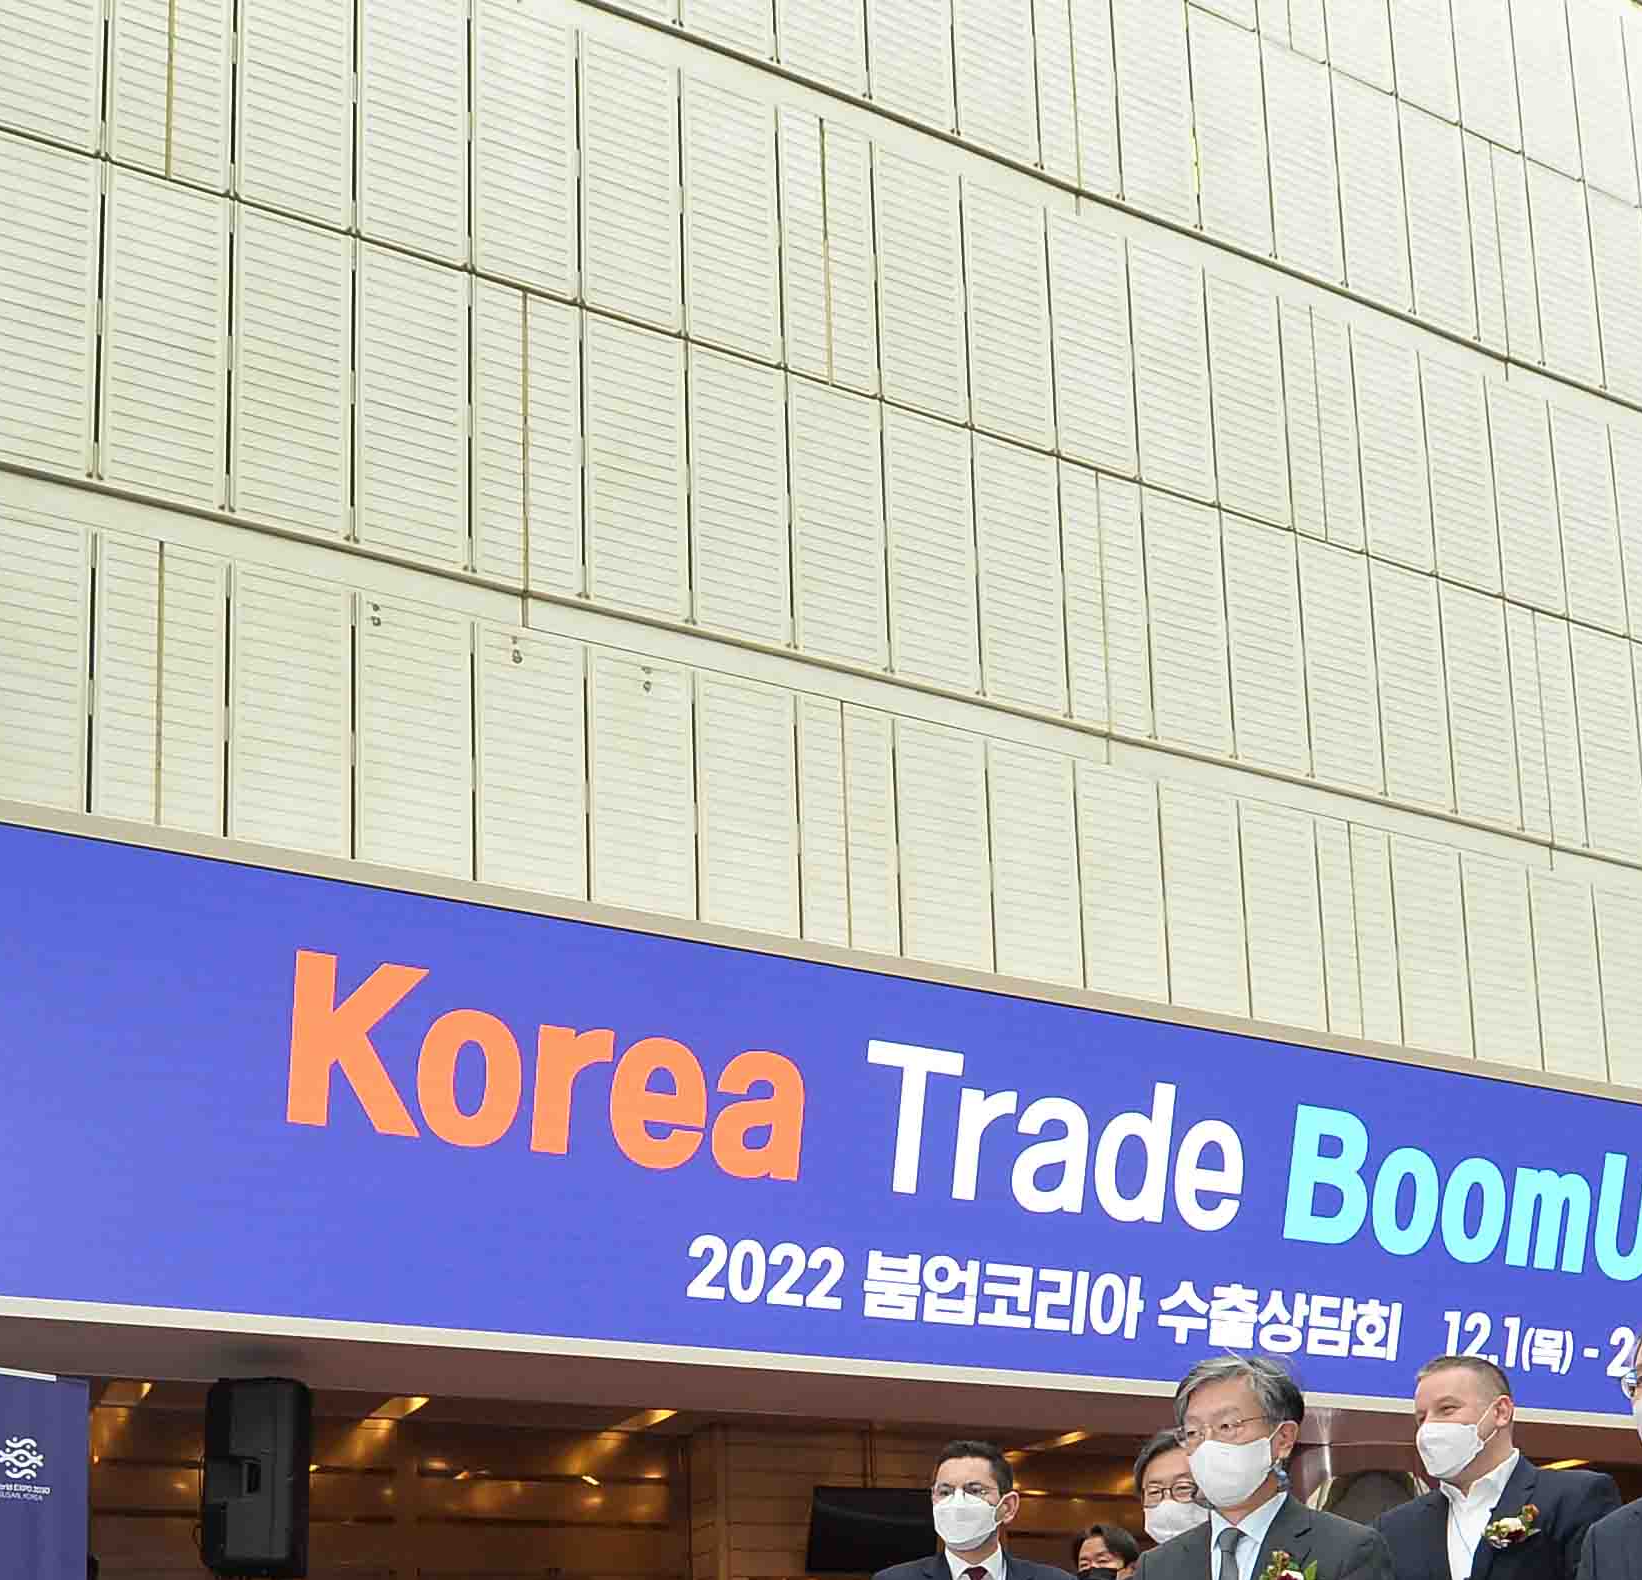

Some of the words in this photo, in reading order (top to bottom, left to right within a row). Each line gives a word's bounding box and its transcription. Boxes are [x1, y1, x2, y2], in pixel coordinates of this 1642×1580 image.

[285, 949, 805, 1182] Korea
[866, 1038, 1245, 1233] Trade
[685, 1233, 844, 1311] 2022
[861, 1249, 1144, 1340] 붐업코리아
[1157, 1282, 1403, 1362] 수출상담회
